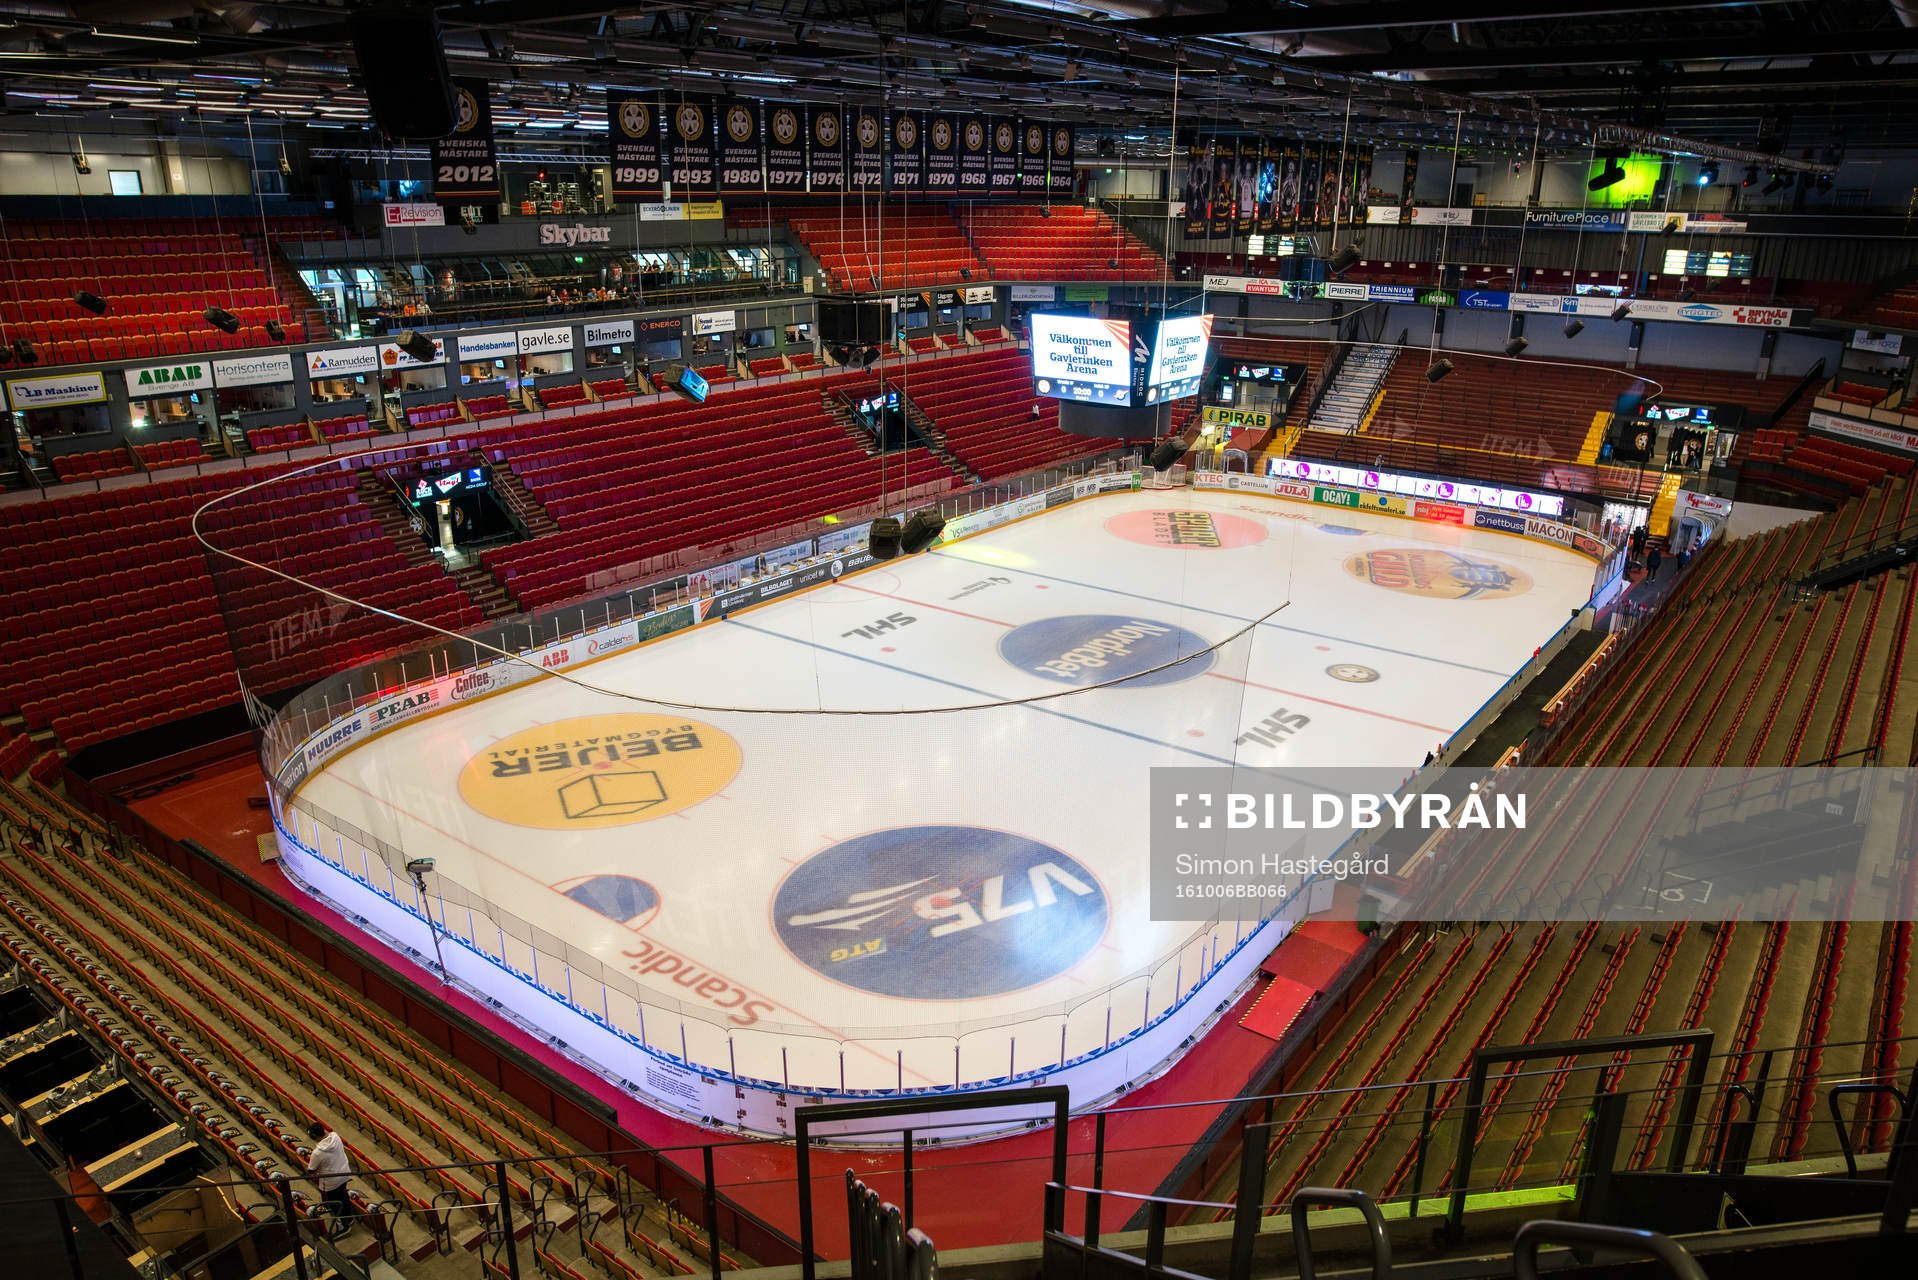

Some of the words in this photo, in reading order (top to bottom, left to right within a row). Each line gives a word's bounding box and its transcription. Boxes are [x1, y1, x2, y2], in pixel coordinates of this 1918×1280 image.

[439, 140, 487, 148] SVENSKA
[617, 144, 655, 152] SVENSKA
[673, 147, 708, 155] SVENSKA
[438, 166, 494, 182] 2012
[615, 167, 659, 183] 1999
[672, 169, 712, 184] 1993
[723, 169, 760, 184] 1980
[769, 171, 803, 184] 1977
[812, 172, 844, 185] 1976
[853, 173, 881, 185] 1972
[893, 173, 919, 185] 1971
[928, 173, 955, 185] 1970
[961, 173, 986, 185] 1968
[992, 174, 1015, 186] 1967
[1022, 174, 1045, 186] 1966
[1050, 175, 1072, 187] 1964
[1526, 211, 1609, 224] FurniturePlace
[539, 224, 611, 248] Skybar
[1208, 278, 1229, 287] MEJ
[1246, 285, 1279, 293] KVANTUM
[1371, 285, 1414, 294] TRIENNIUM
[1331, 287, 1363, 295] PIERRE
[1747, 316, 1772, 325] GLAS
[1748, 308, 1788, 320] BRYNÄS
[650, 319, 681, 329] ENERCO
[522, 331, 570, 350] gavle.se
[587, 328, 632, 342] Bilmetro
[1049, 332, 1112, 348] Välkommen
[460, 339, 515, 353] Handelsbanken
[1073, 345, 1088, 355] till
[328, 355, 376, 368] Ramudden
[1049, 351, 1113, 368] Gavlerinken
[137, 365, 203, 385] ABAB
[216, 360, 289, 376] Horisonterra
[1066, 363, 1098, 376] Arena
[1169, 364, 1188, 375] Arena
[45, 384, 99, 396] Maskiner
[1218, 410, 1267, 427] PIRAB
[1240, 480, 1269, 489] CASTELLUM
[1276, 484, 1307, 497] JULA
[1322, 490, 1350, 505] OCAY!
[1152, 512, 1171, 544] BLADET
[1173, 511, 1222, 547] SPORT
[1486, 516, 1524, 531] nettbuss
[1527, 520, 1573, 543] MACON
[799, 570, 818, 584] unicef
[760, 577, 793, 594] BILBOLAGET
[842, 612, 918, 640] SHL
[268, 607, 322, 662] ITEM
[1035, 619, 1169, 679] NordicBet
[542, 649, 570, 667] ABB
[455, 671, 489, 694] Coffee
[376, 691, 431, 722] PEAB
[1235, 706, 1312, 749] SHL
[307, 719, 362, 760] HUURRE
[488, 724, 693, 759] BYGGMATERIAL
[492, 732, 703, 778] BEIJER
[930, 862, 1095, 938] V75
[831, 938, 882, 962] ATG
[621, 940, 774, 1026] Scandic
